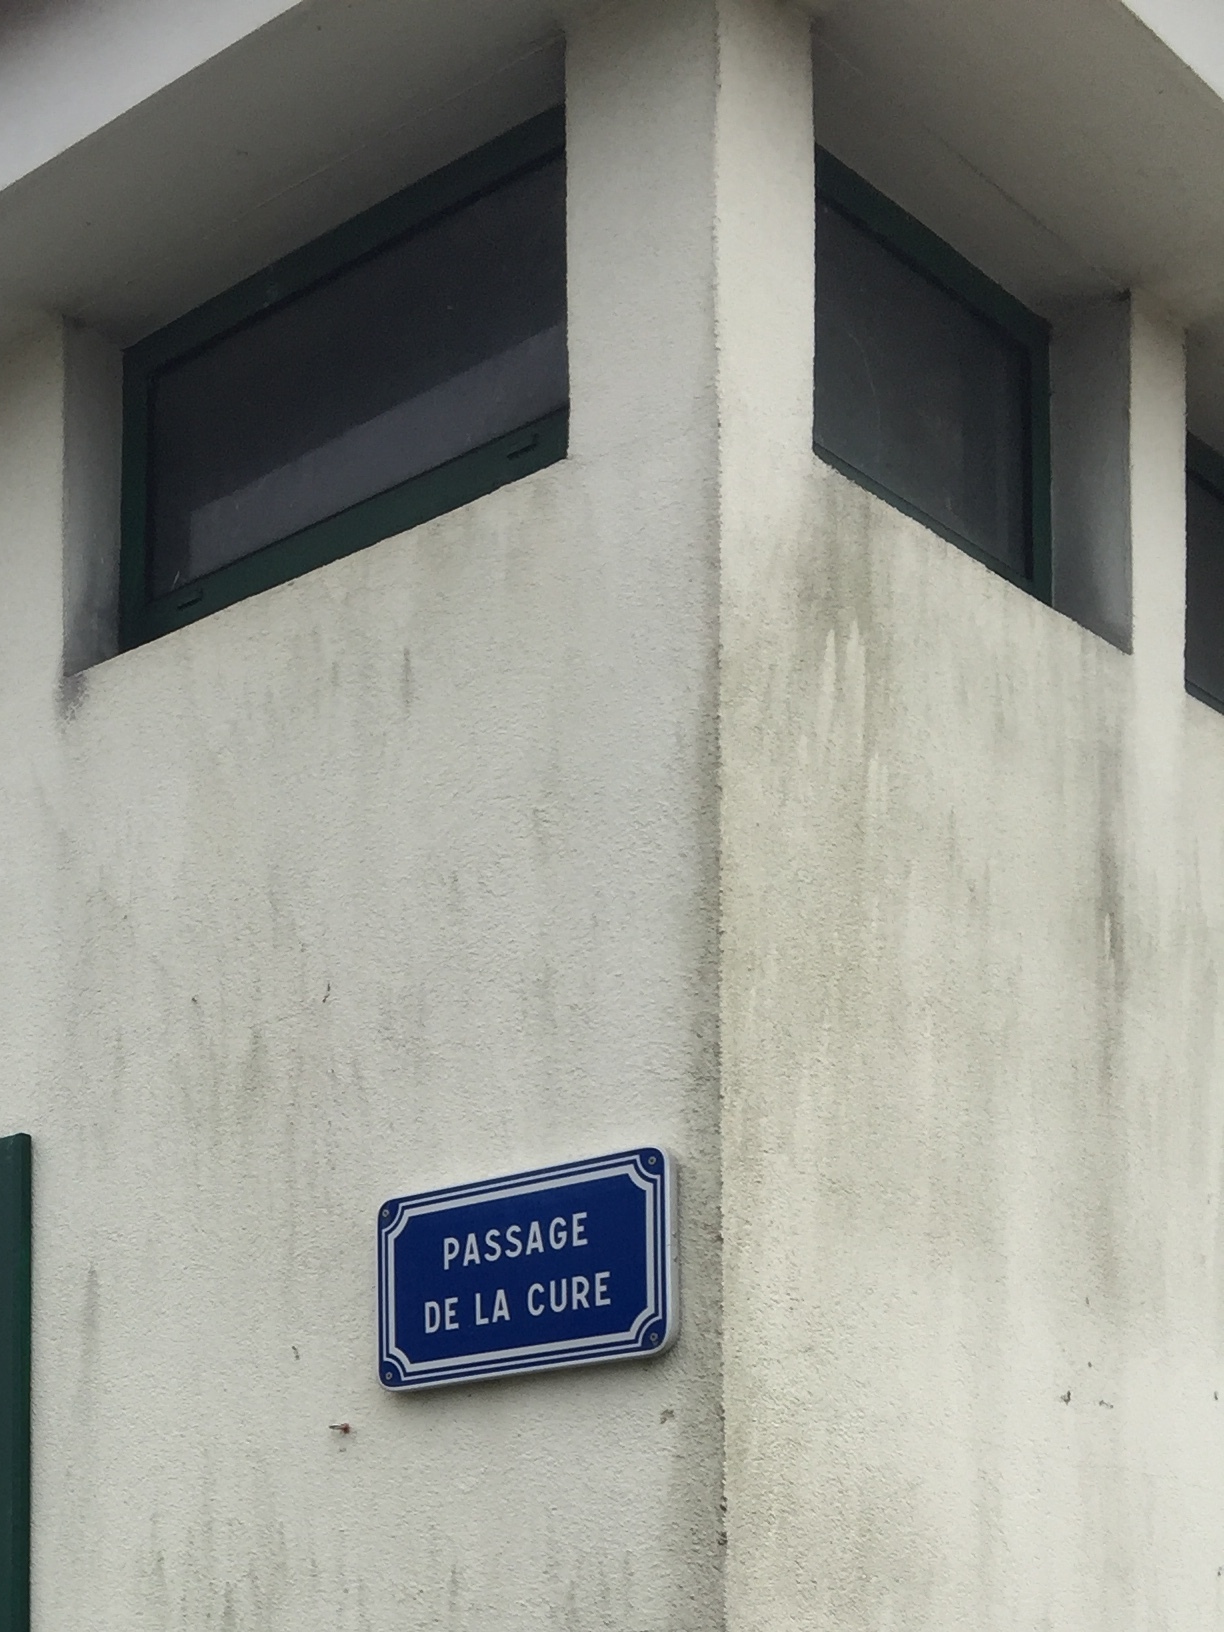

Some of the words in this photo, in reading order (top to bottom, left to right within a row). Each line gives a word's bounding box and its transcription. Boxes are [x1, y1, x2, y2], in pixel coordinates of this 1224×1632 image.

[443, 1212, 588, 1270] PASSAGE
[425, 1297, 459, 1334] DE
[475, 1289, 510, 1325] LA
[527, 1271, 611, 1316] CURE
